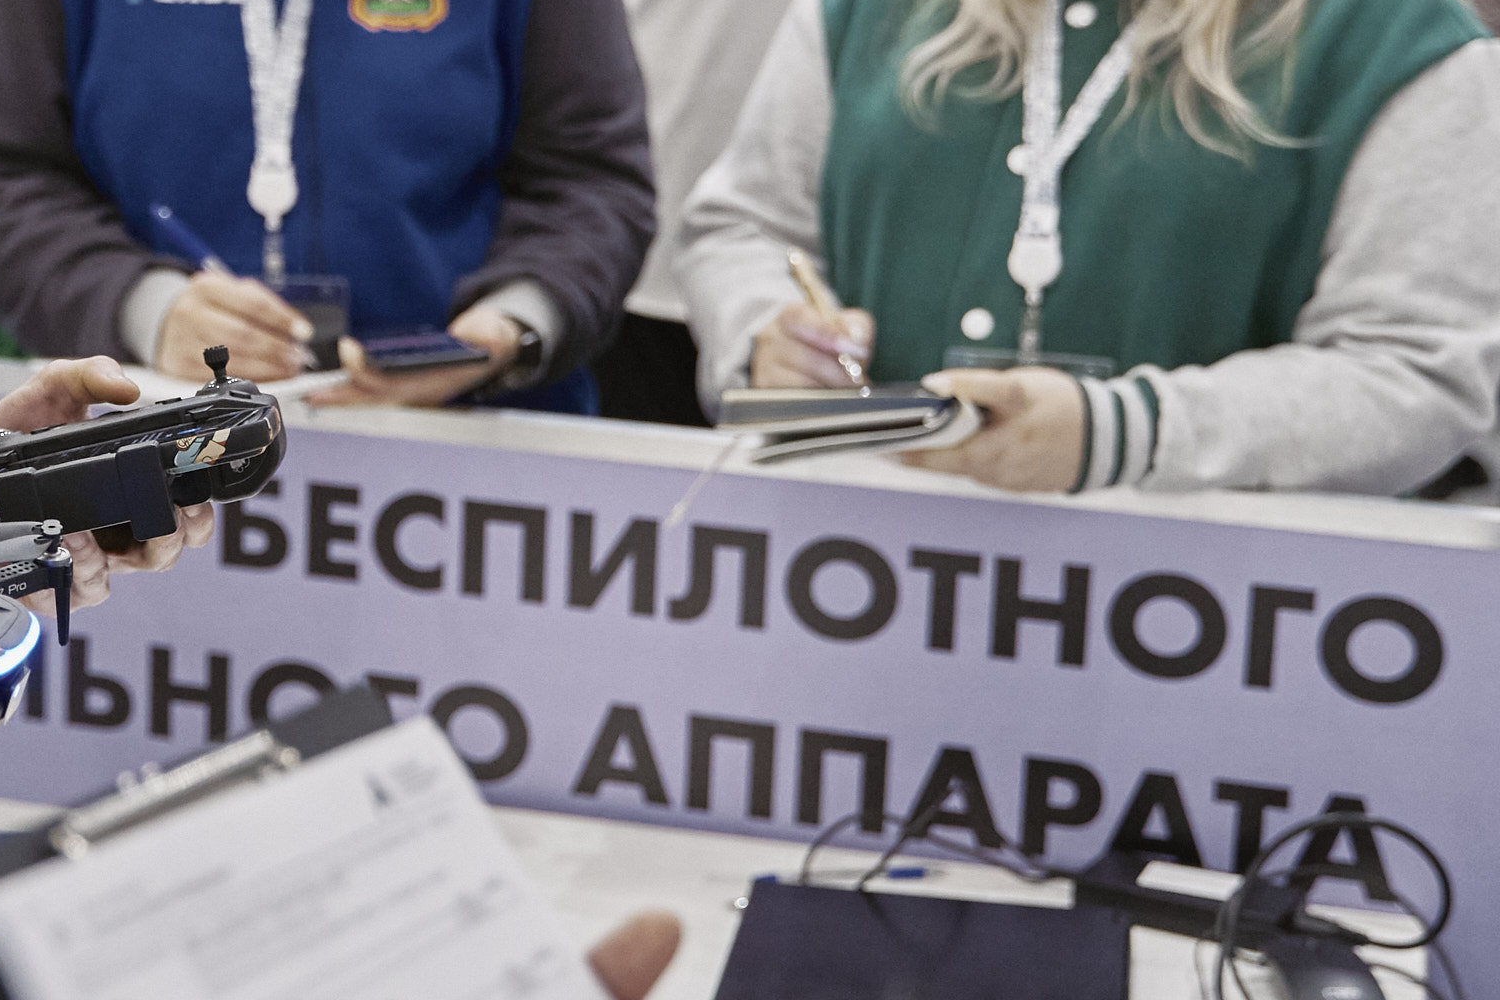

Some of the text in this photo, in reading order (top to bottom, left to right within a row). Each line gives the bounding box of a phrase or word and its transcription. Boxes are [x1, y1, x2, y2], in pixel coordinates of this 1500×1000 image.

[8, 582, 27, 595] Pro
[220, 480, 1444, 705] БЕСПИЛОТНОГО
[573, 703, 1400, 904] АППАРАТА
